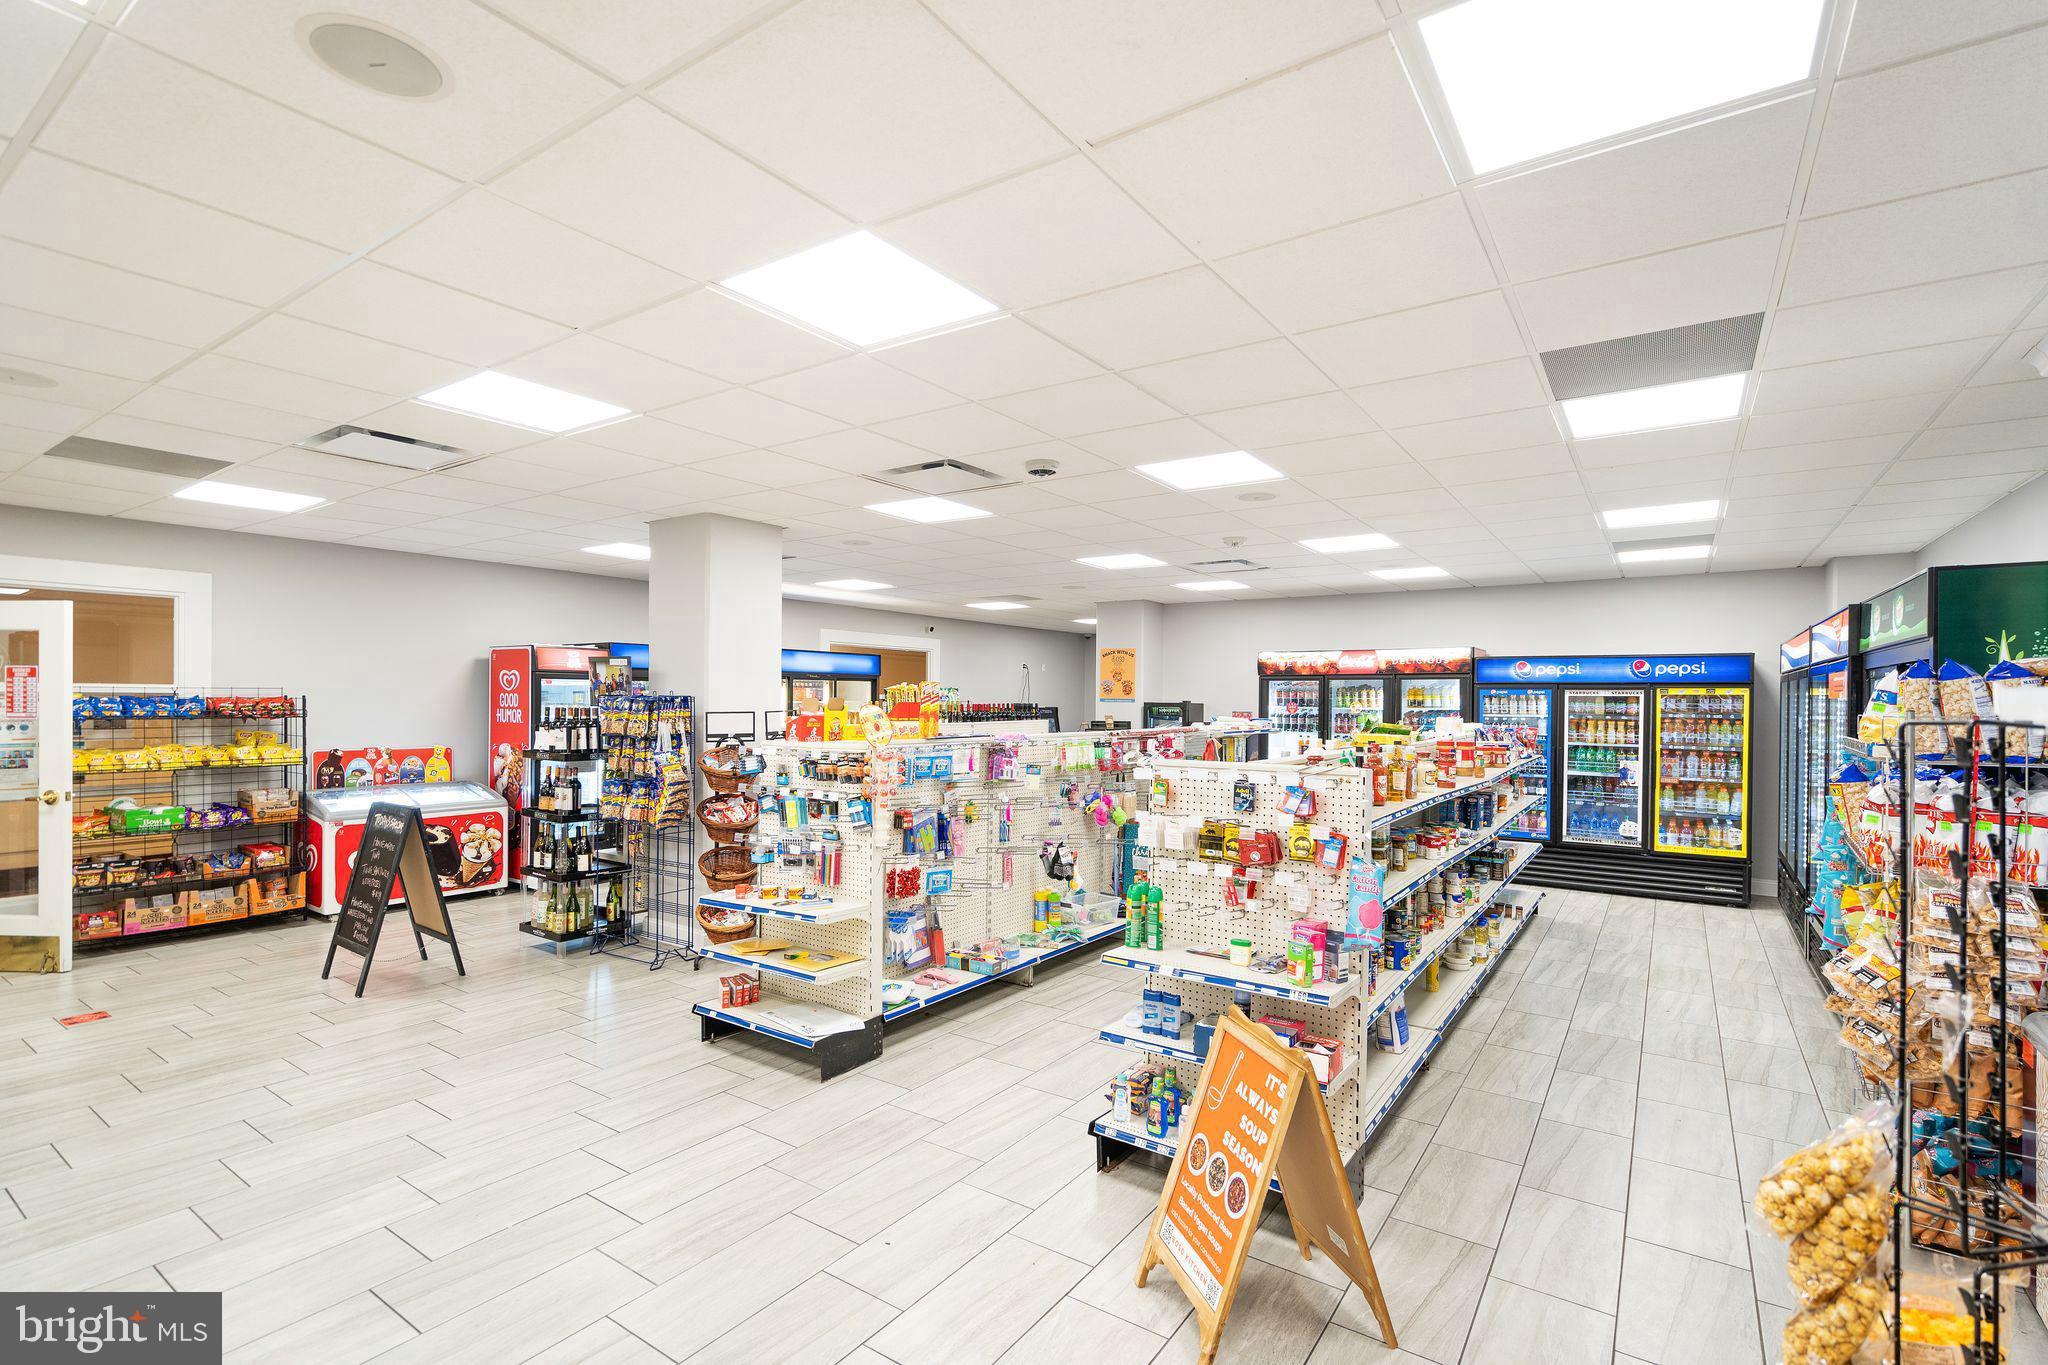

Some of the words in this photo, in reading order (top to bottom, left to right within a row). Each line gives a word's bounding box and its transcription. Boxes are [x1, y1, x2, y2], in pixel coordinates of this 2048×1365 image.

[1391, 656, 1449, 666] DELICIOUS
[1535, 662, 1581, 677] pepsi
[1655, 662, 1706, 677] pepsi
[499, 693, 519, 707] GOOD
[496, 708, 523, 724] HUMOR
[1265, 1073, 1288, 1099] IT'S
[1235, 1081, 1279, 1125] ALWAYS
[1240, 1114, 1268, 1146] SOUP
[1222, 1131, 1263, 1178] SEASON
[1179, 1196, 1195, 1218] Based
[1193, 1209, 1209, 1236] Vegan
[1181, 1175, 1198, 1200] Locally
[1219, 1219, 1233, 1240] Bean
[1184, 1252, 1207, 1287] KITCHEN
